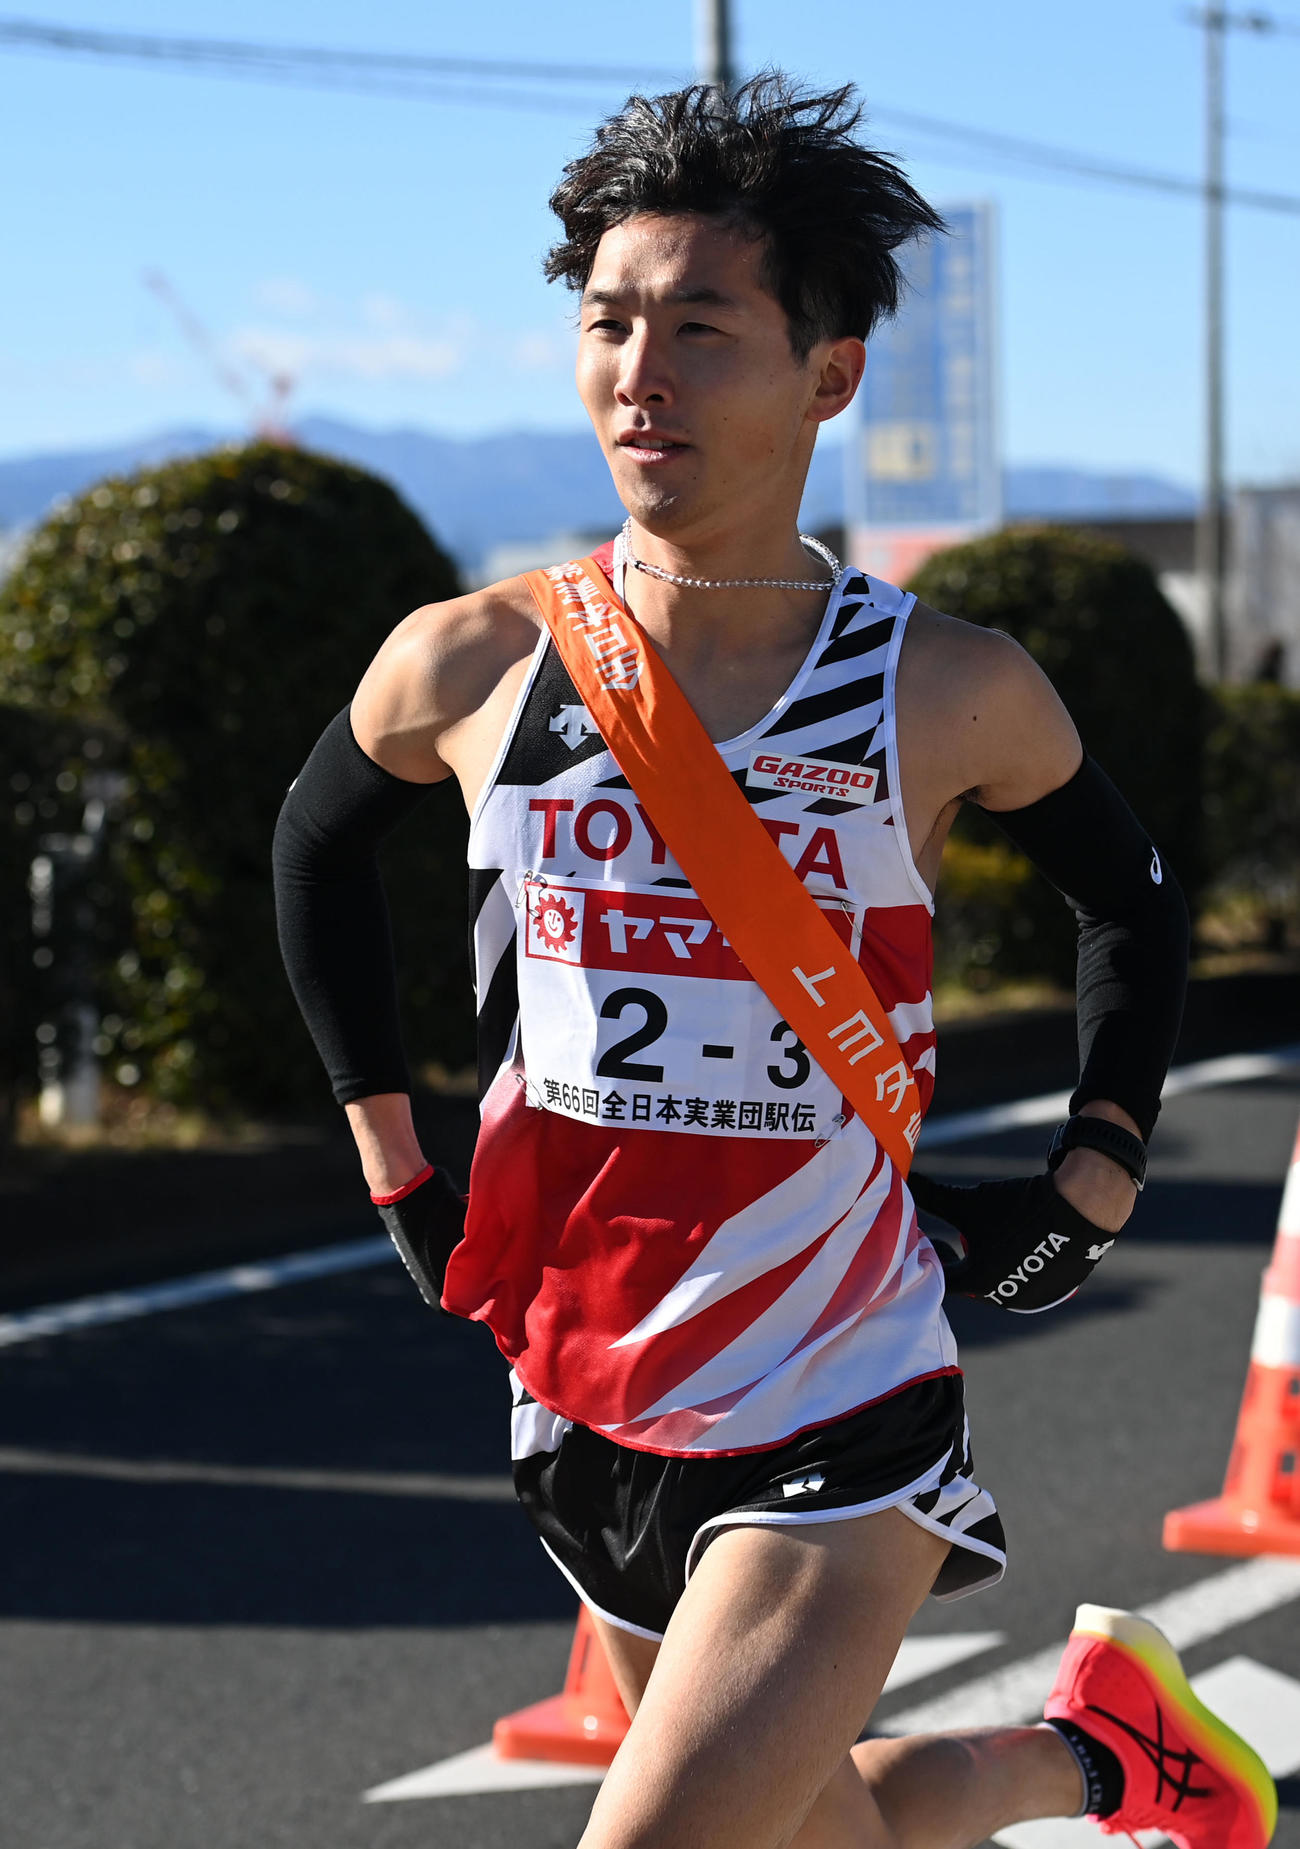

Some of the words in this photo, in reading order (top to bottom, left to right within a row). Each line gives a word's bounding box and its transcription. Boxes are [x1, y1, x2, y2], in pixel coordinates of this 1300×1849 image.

[753, 755, 874, 789] GAZOO
[773, 777, 850, 797] SPORTS
[529, 799, 848, 890] TOYA
[600, 909, 742, 962] ヤマ
[543, 1077, 816, 1132] 第66回全日本実業団駅伝
[984, 1232, 1070, 1305] TOYOTA
